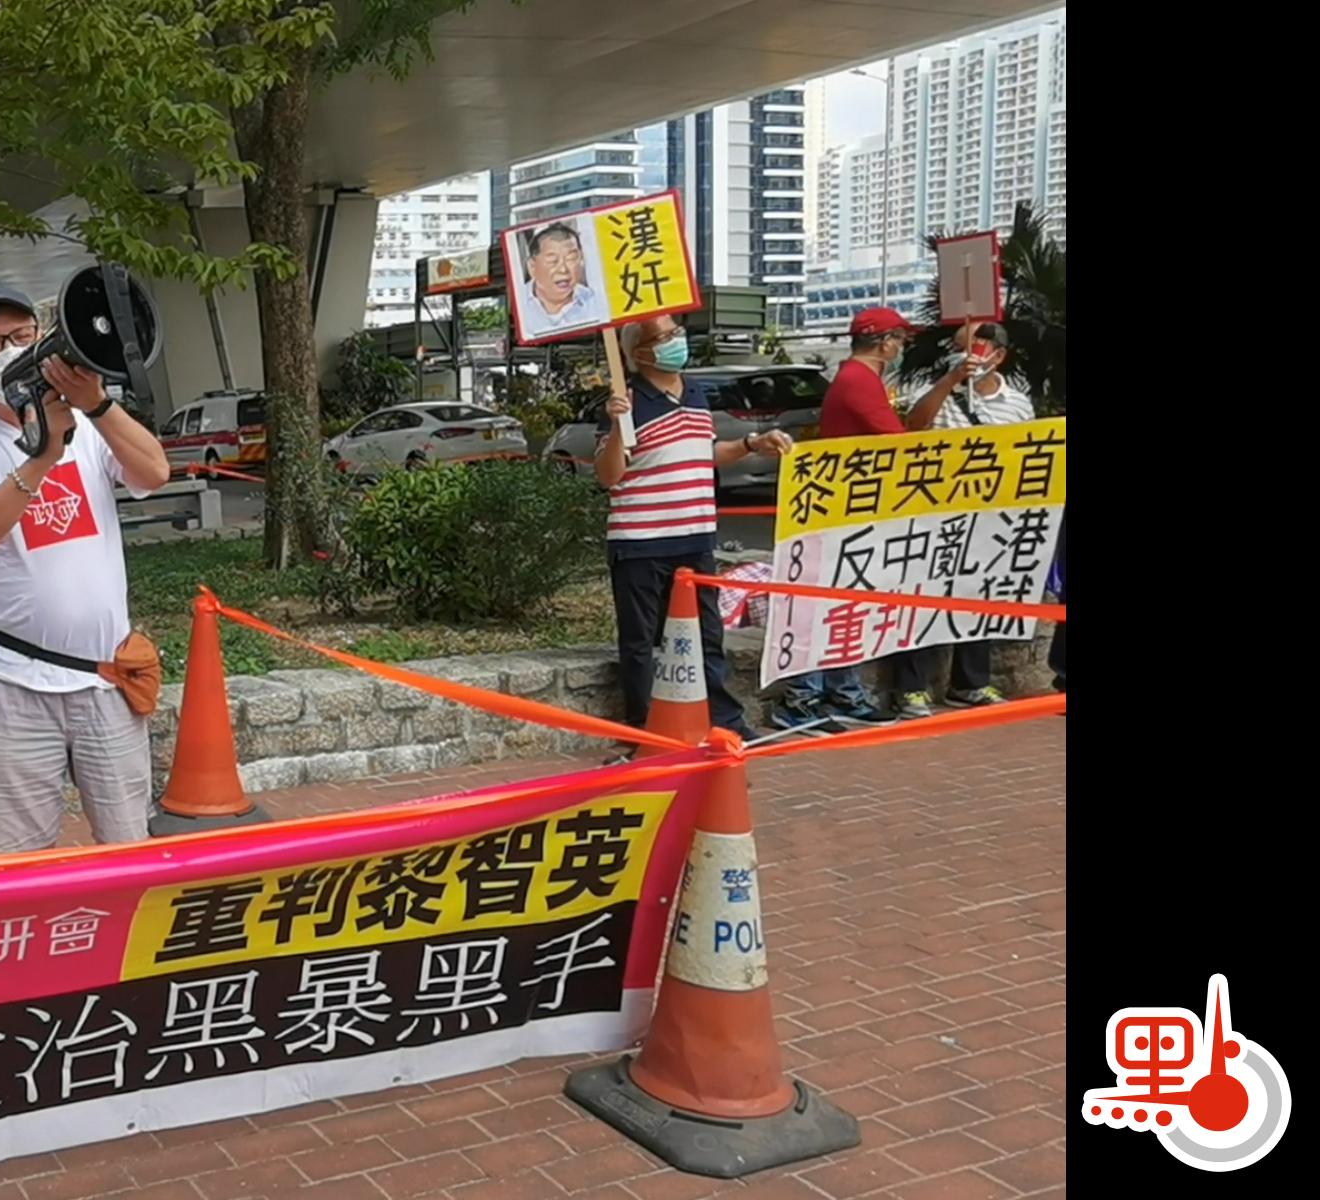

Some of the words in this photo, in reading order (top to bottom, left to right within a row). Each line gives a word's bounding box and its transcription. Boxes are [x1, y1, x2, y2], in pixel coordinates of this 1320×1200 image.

[608, 207, 669, 312] 漢奸
[790, 429, 1066, 525] 黎智英為首
[831, 508, 1049, 590] 反中亂港
[653, 659, 697, 683] OLICE
[154, 807, 644, 963] 重判黎智英
